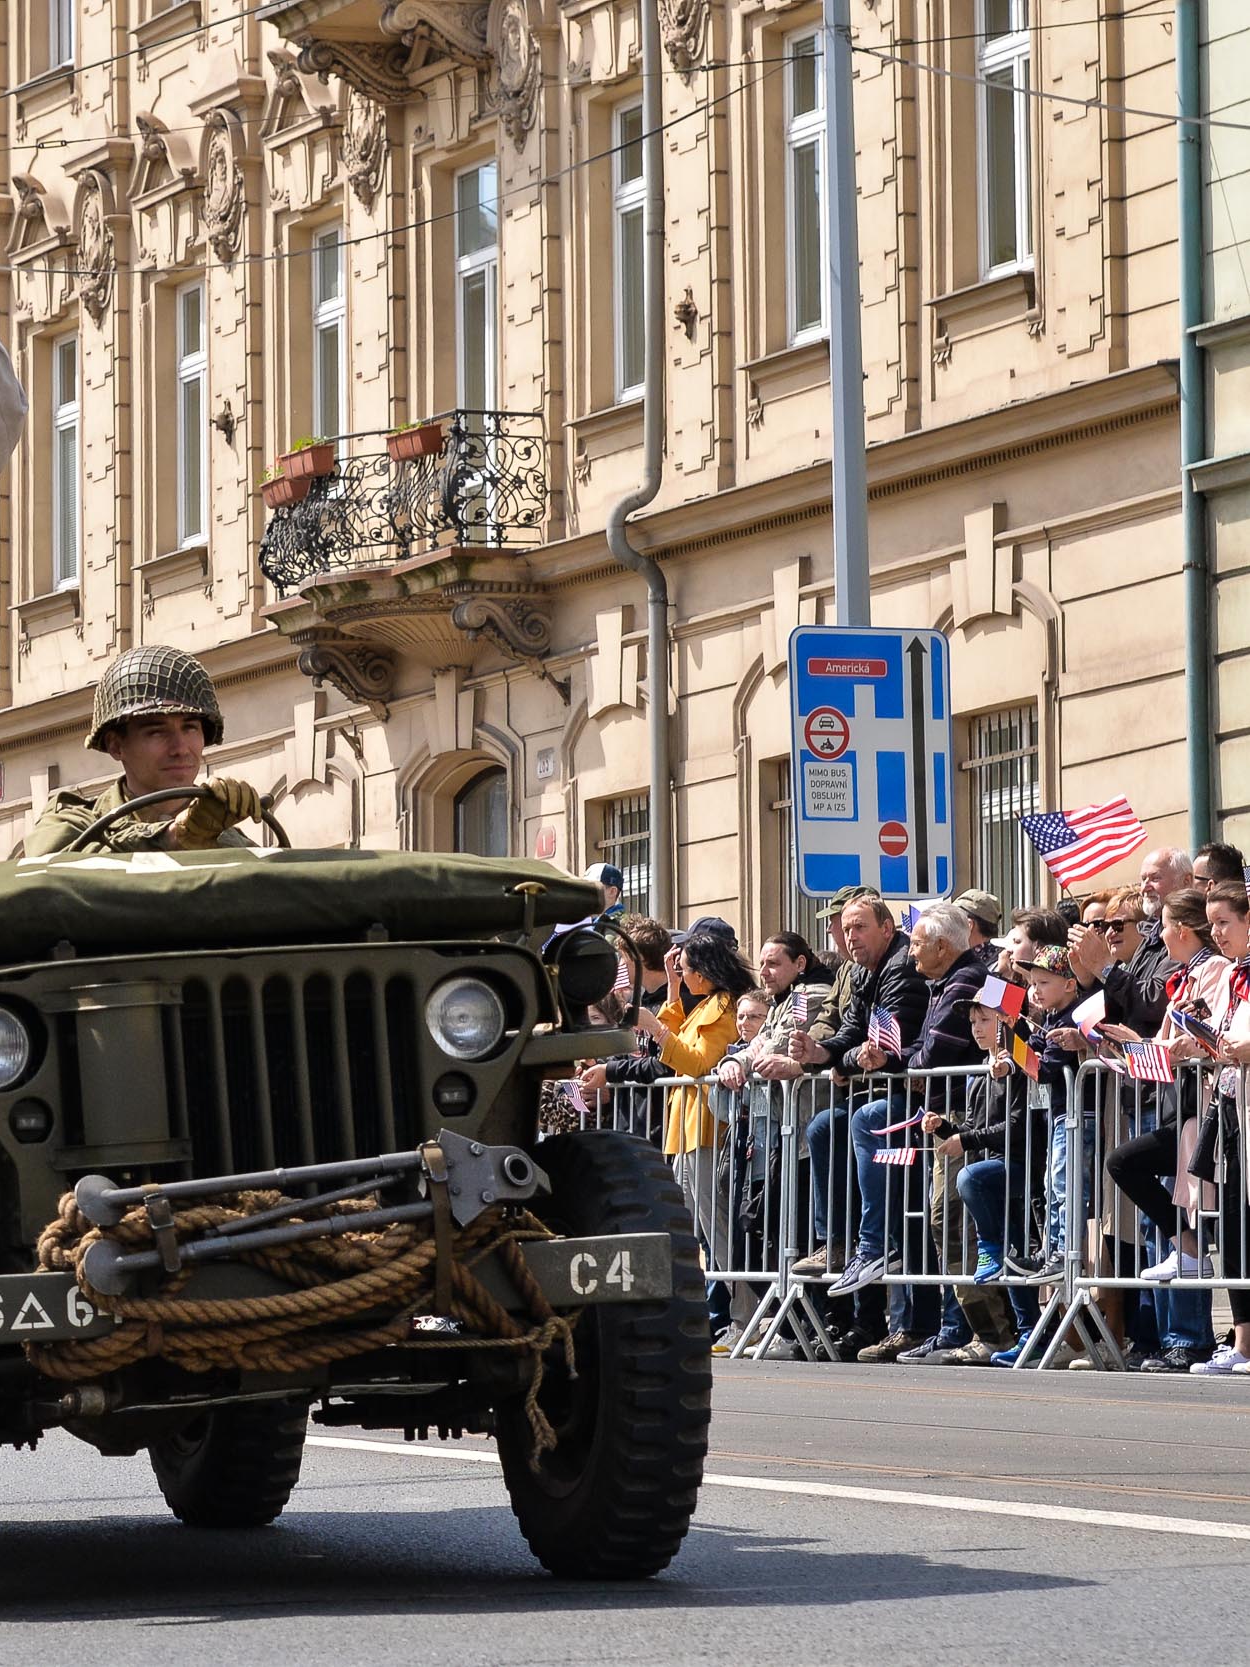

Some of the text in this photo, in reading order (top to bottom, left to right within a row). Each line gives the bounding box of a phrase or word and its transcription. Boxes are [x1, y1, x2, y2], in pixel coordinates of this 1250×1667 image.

[825, 661, 870, 674] Americká
[808, 768, 829, 777] MIMO
[810, 778, 848, 789] DOPRAVNÍ
[813, 803, 846, 812] MP A IZS
